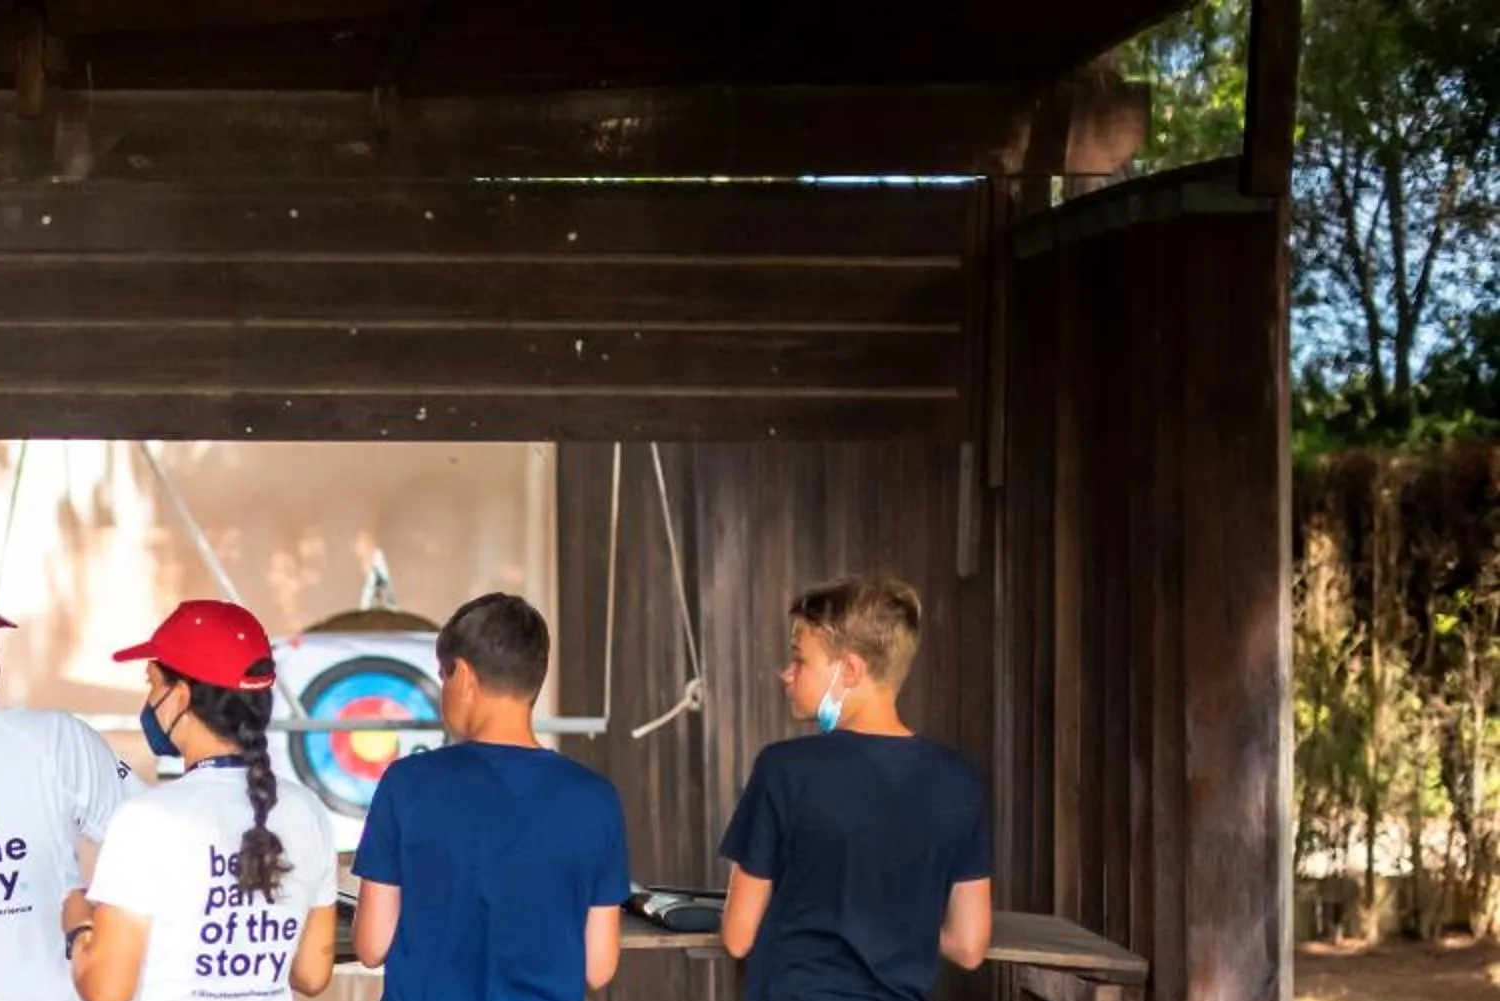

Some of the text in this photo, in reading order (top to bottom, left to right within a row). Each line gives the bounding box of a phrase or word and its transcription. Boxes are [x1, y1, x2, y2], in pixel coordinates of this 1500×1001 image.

[204, 883, 275, 916] par
[200, 910, 298, 945] of the
[195, 950, 287, 983] story
